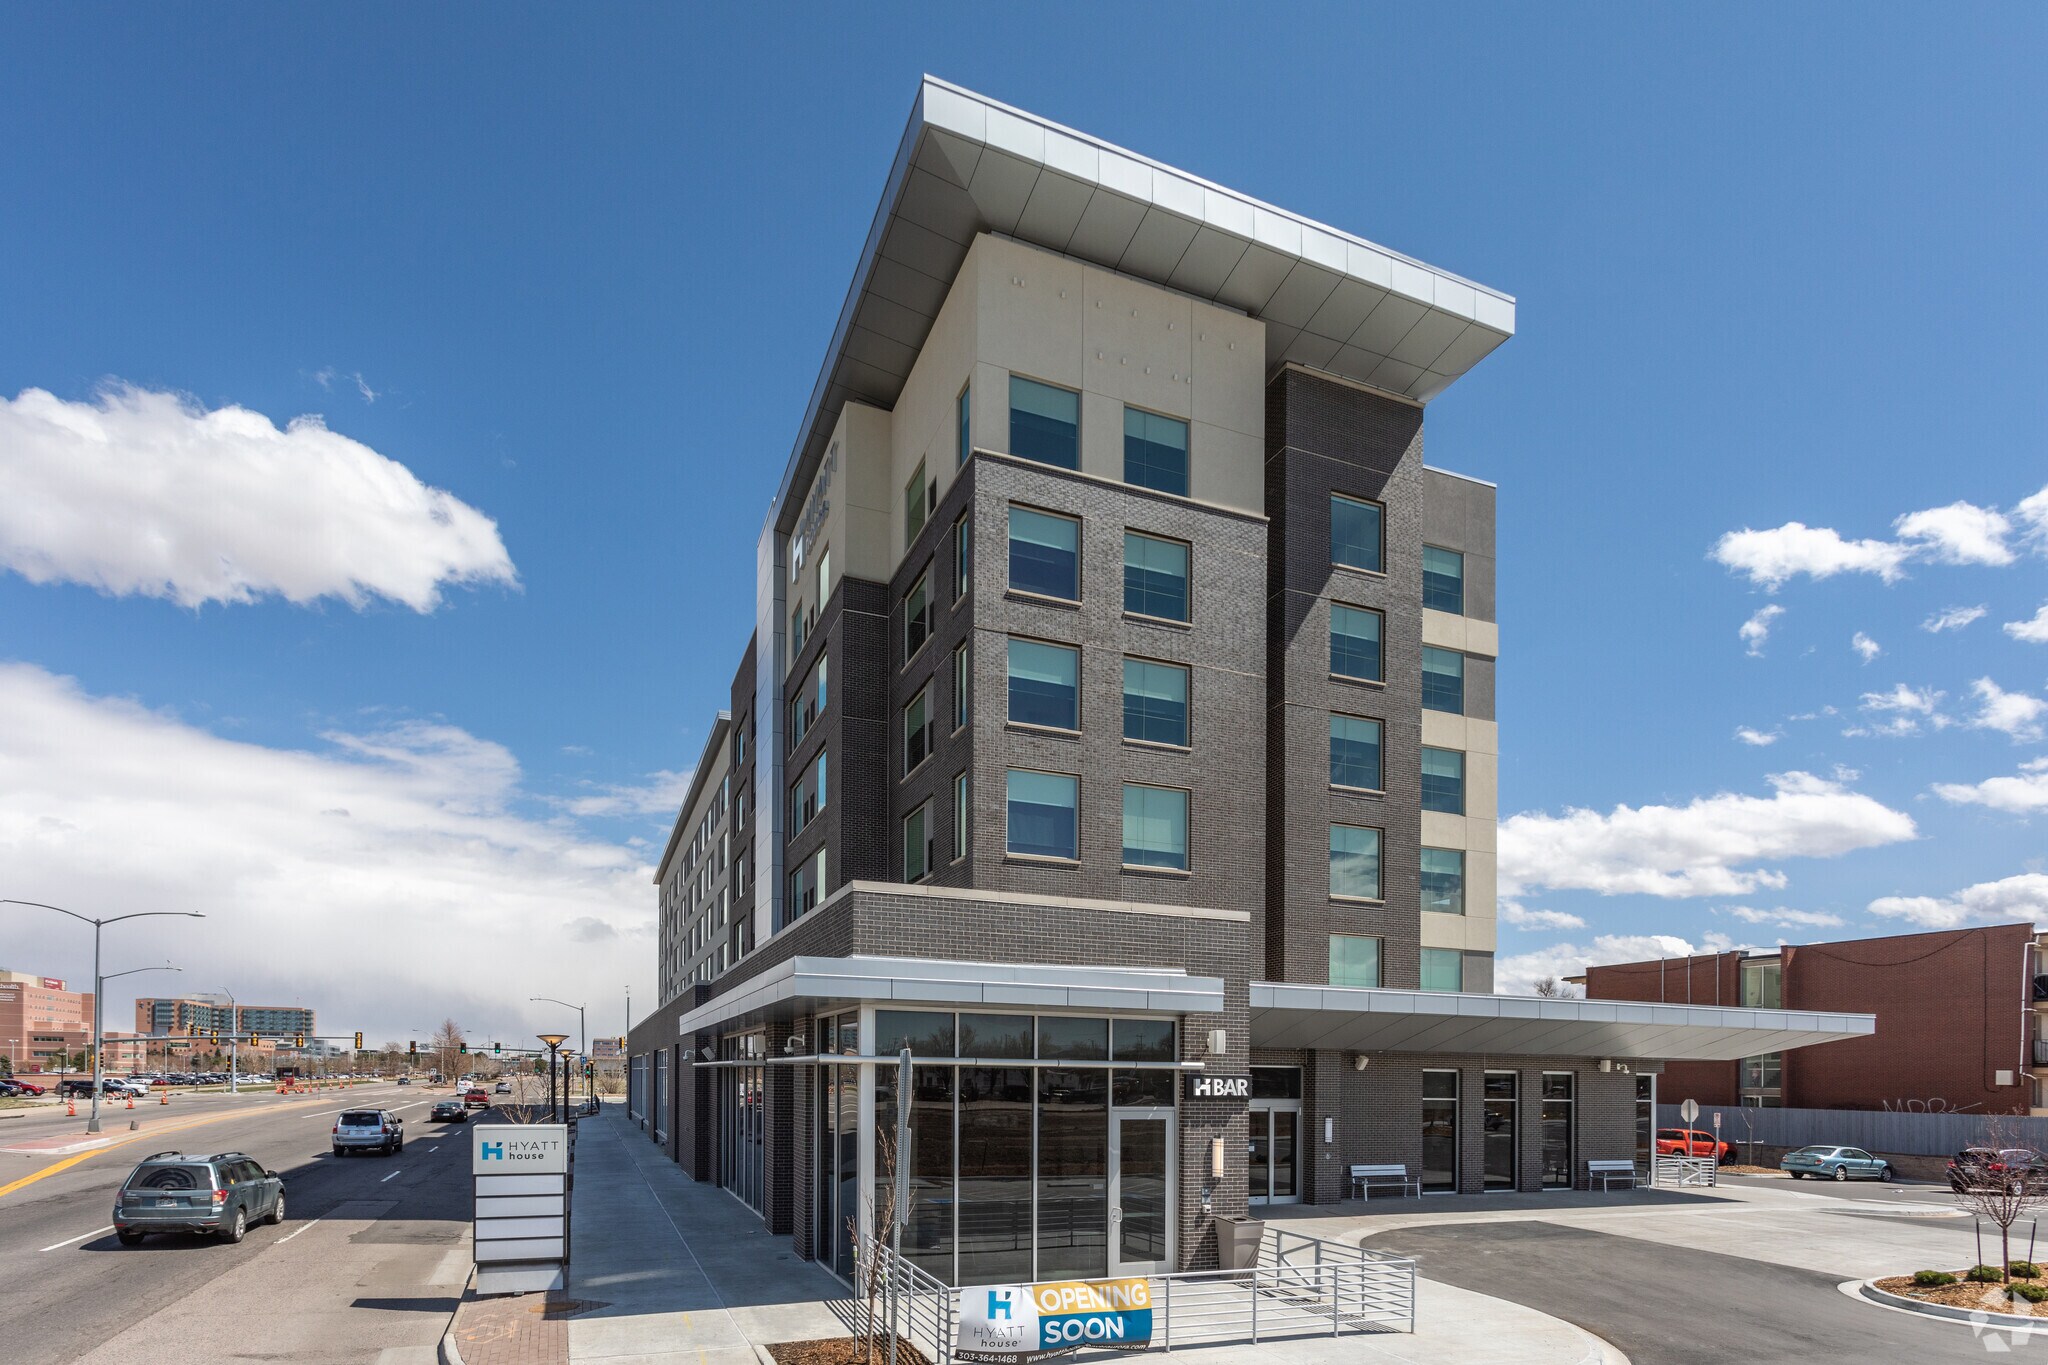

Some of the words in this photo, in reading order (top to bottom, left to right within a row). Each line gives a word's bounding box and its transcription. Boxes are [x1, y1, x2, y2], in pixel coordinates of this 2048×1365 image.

[1213, 1078, 1248, 1096] BAR
[509, 1141, 559, 1151] HYATT
[509, 1152, 545, 1160] house
[1040, 1283, 1147, 1311] OPENING
[973, 1325, 1025, 1338] HYATT
[1044, 1316, 1124, 1343] SOON
[980, 1338, 1018, 1348] house
[958, 1352, 1018, 1363] 303-364-1468
